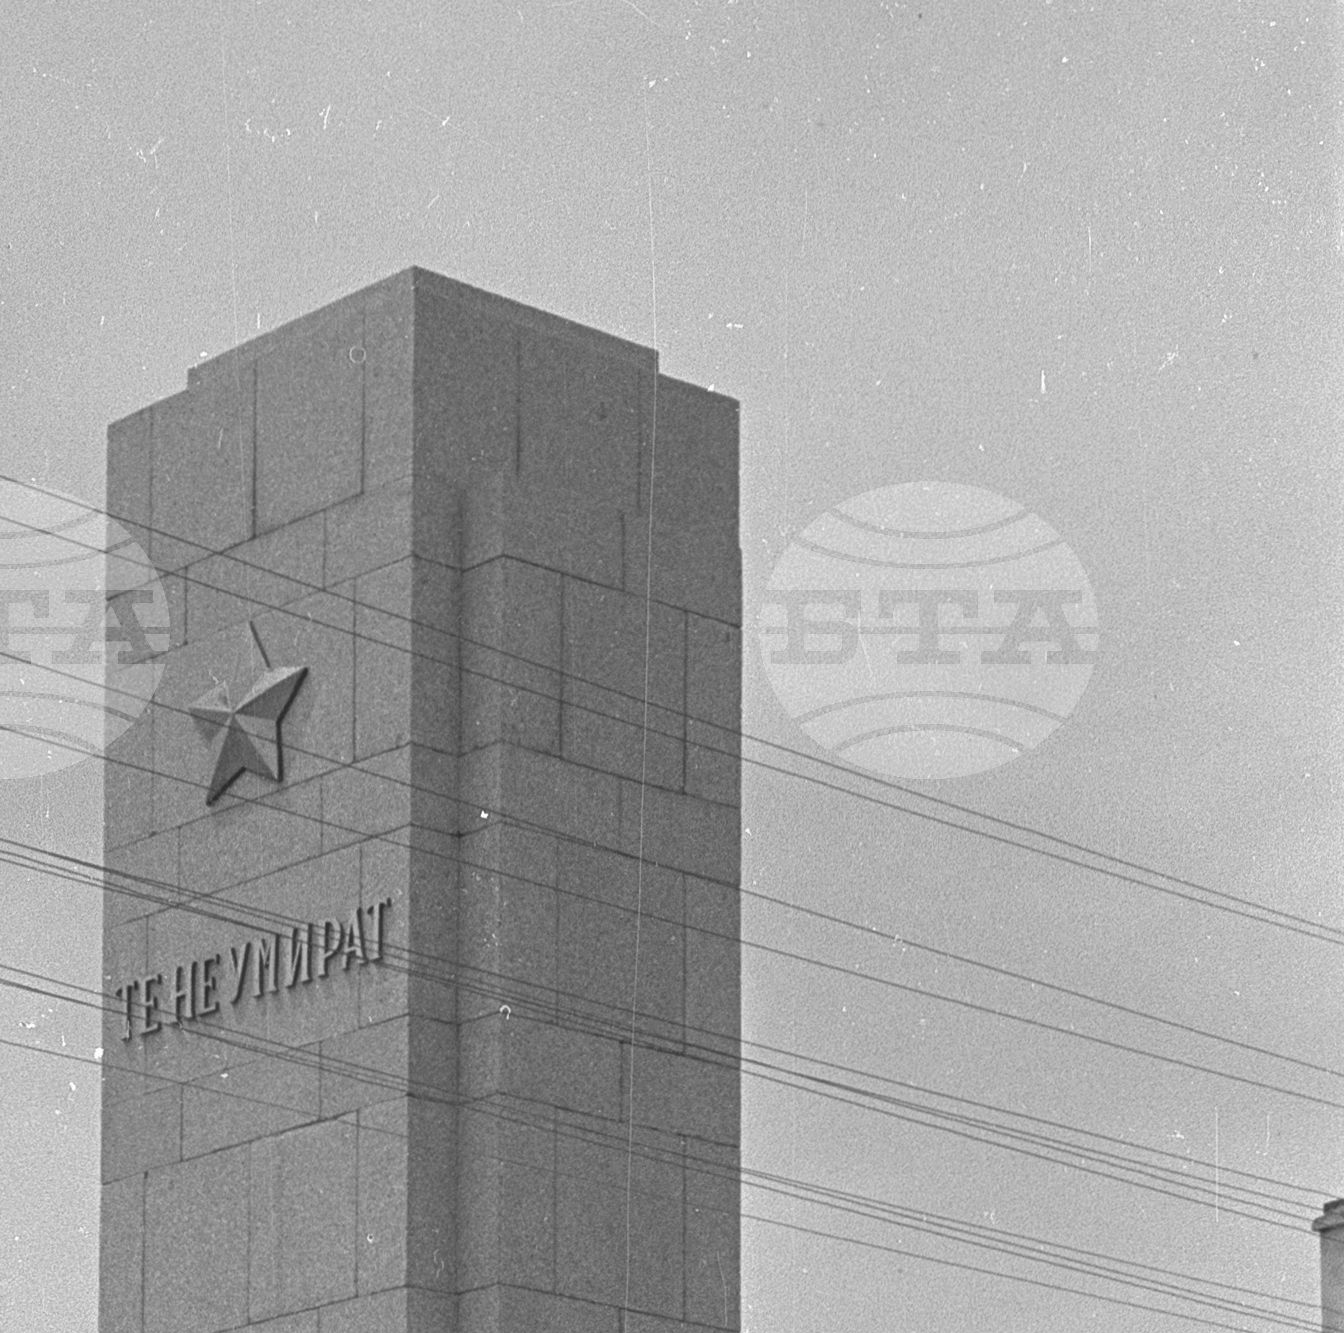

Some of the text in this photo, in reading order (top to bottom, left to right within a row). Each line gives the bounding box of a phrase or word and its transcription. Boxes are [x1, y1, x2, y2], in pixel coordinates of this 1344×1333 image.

[116, 897, 392, 1041] ТЕ НЕ УМИРАТ
